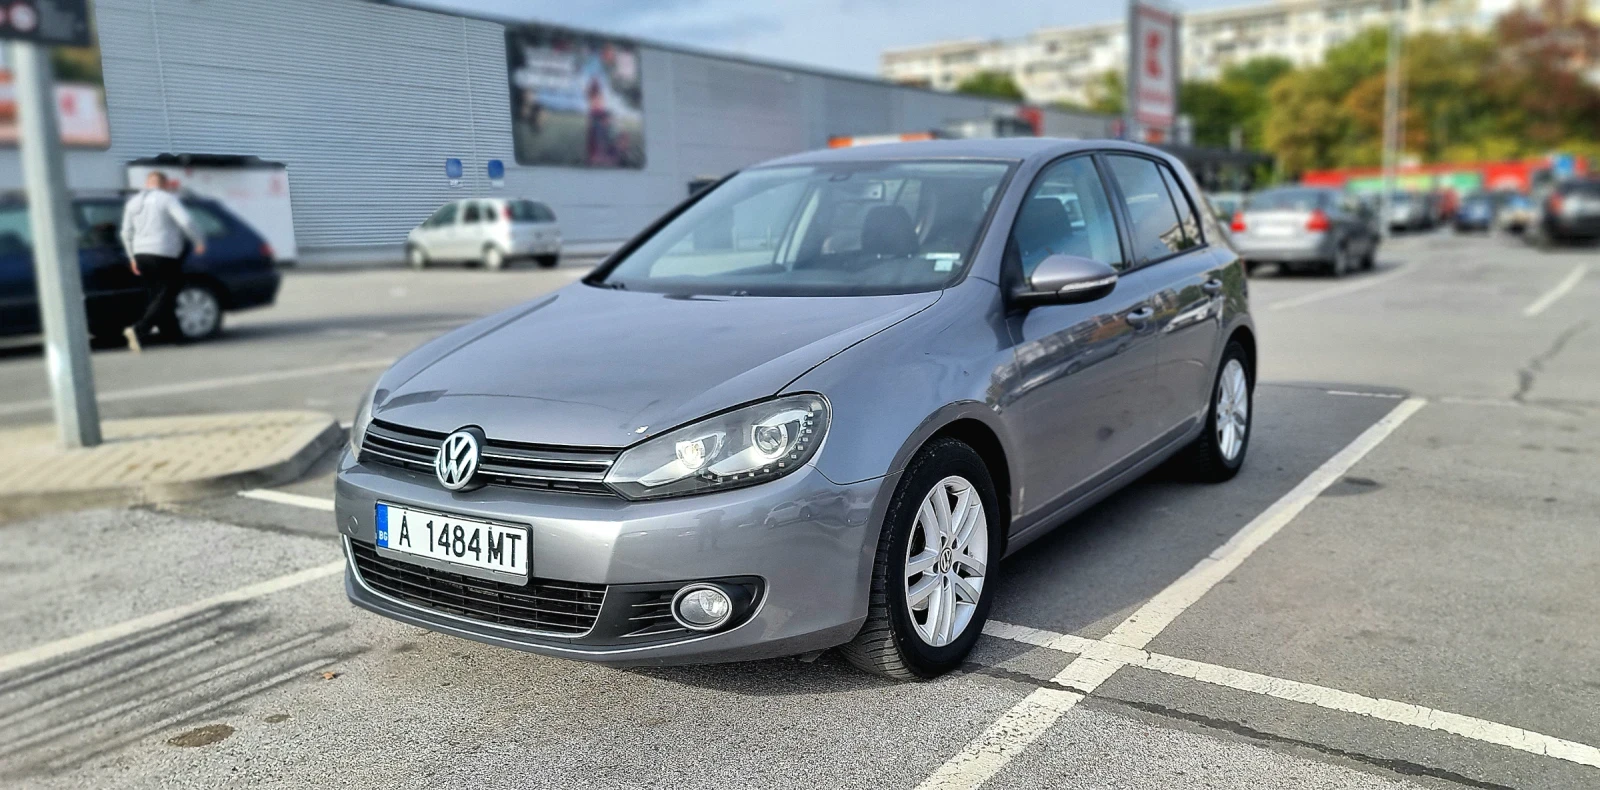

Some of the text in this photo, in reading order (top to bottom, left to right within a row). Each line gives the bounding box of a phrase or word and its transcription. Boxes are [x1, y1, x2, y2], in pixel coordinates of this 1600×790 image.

[438, 432, 478, 489] VW
[378, 531, 388, 540] BG
[399, 513, 411, 547] A
